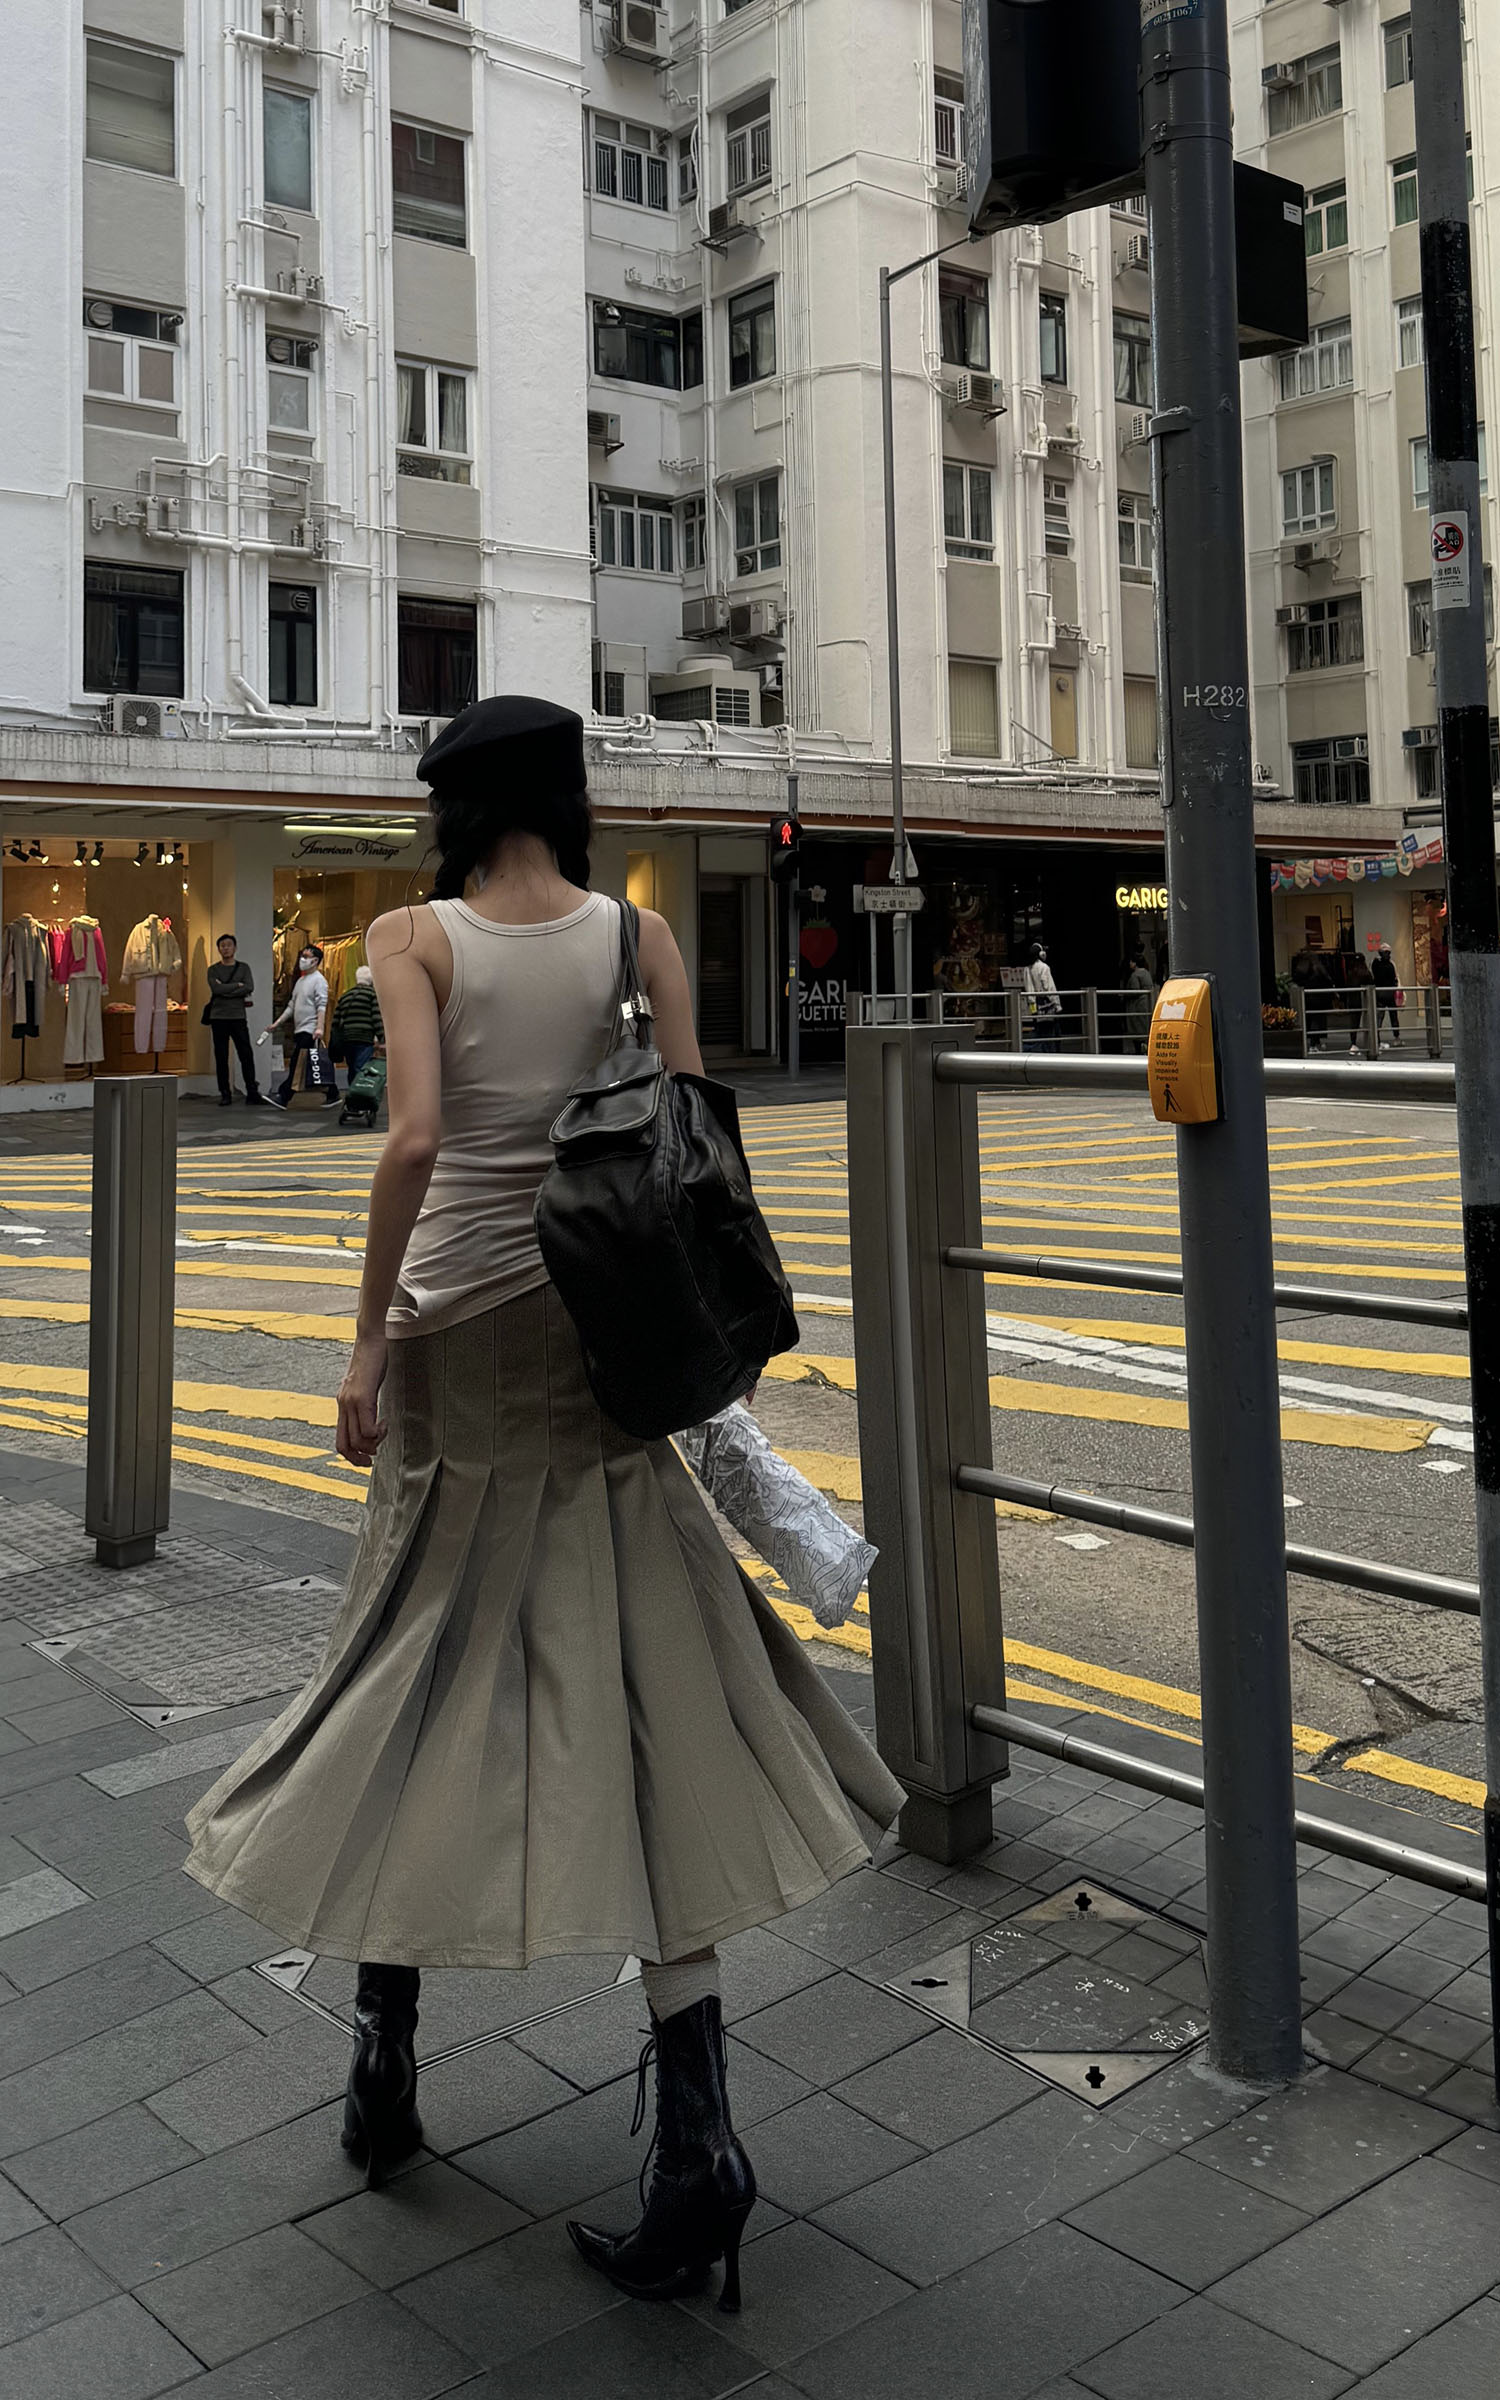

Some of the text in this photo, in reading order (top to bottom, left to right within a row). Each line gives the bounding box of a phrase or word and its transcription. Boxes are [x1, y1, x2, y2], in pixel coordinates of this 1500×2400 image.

[1183, 685, 1246, 708] H282
[292, 834, 400, 861] American Vintage
[891, 888, 911, 896] Street
[1115, 887, 1168, 908] GARIG
[309, 1048, 321, 1084] LOG-ON
